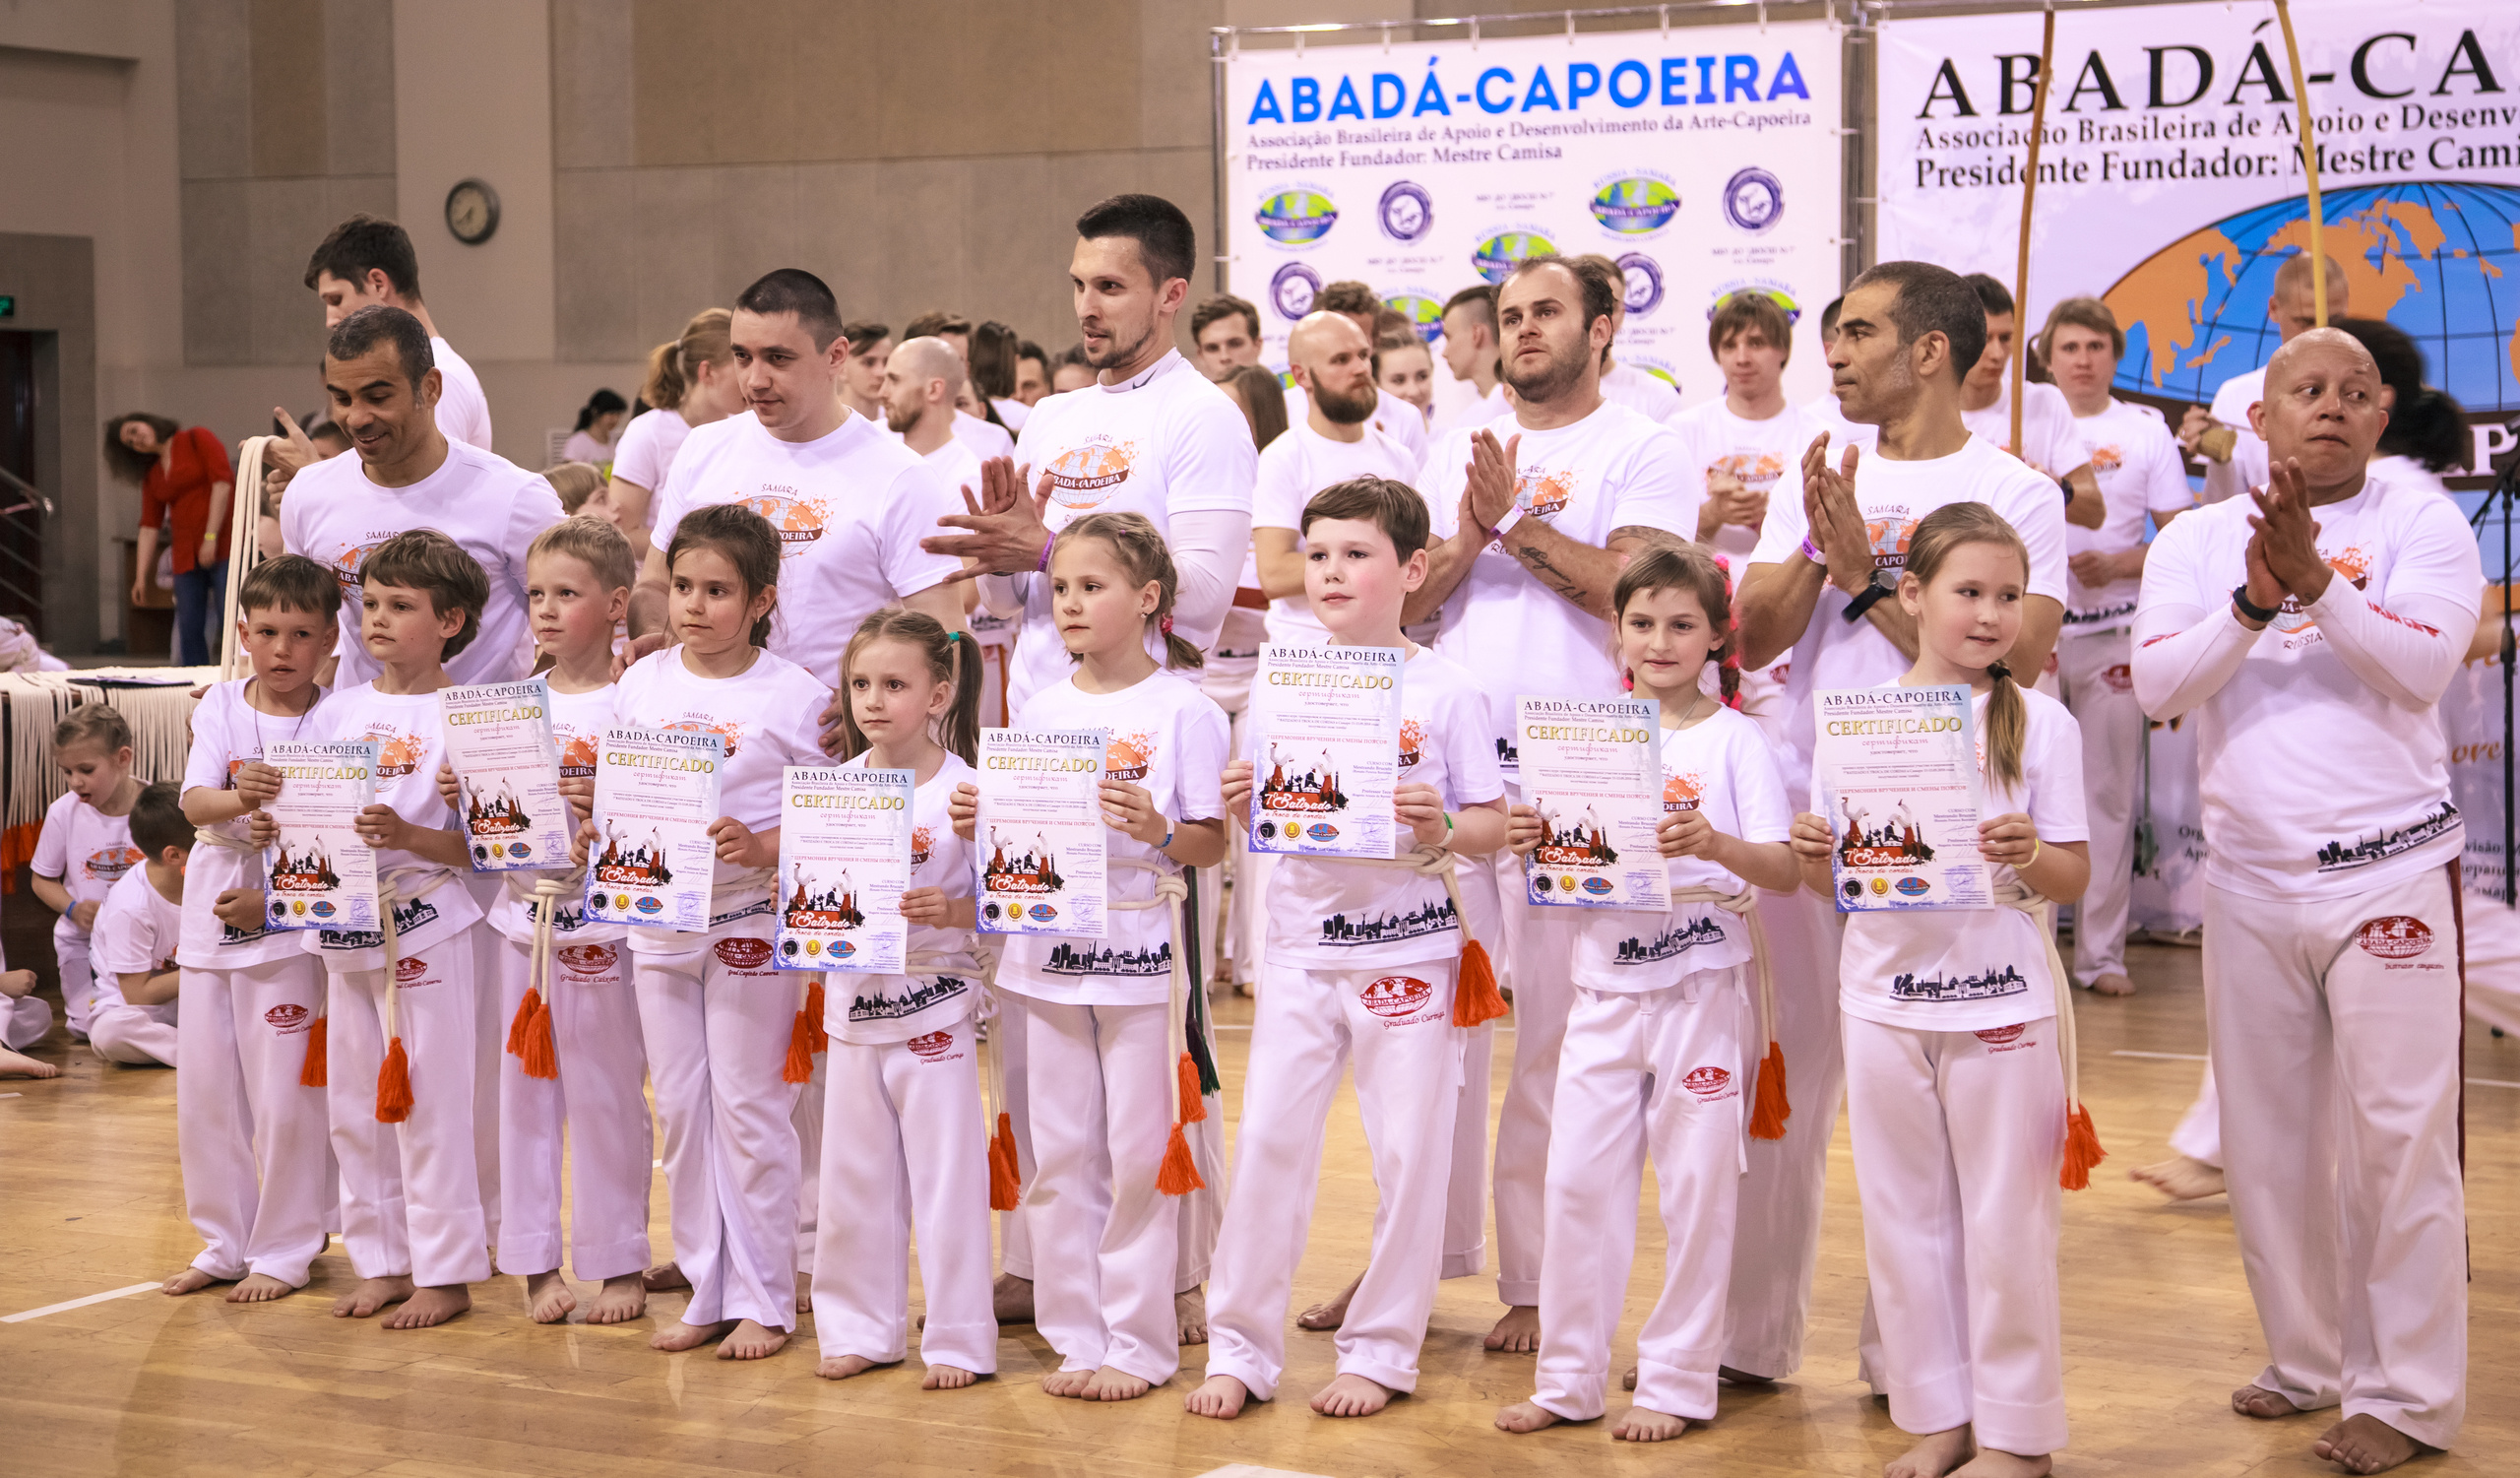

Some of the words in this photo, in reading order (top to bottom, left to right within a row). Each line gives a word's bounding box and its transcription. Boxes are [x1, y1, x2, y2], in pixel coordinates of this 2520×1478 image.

[1916, 18, 2520, 119] ABADÁ-CA
[1247, 49, 1811, 125] ABADÁ-CAPOEIRA
[1248, 132, 1332, 151] Associação
[1337, 128, 1412, 145] Brasileira
[1418, 126, 1437, 142] de
[1441, 124, 1491, 145] Apoio
[1496, 126, 1505, 138] e
[1510, 117, 1659, 138] Desenvolvimento
[1664, 115, 1684, 131] da
[1689, 109, 1812, 133] Arte-Capoeira
[2079, 113, 2216, 144] Brasileira
[2229, 110, 2261, 137] de
[2374, 112, 2390, 130] e
[1247, 151, 1335, 171] Presidente
[1340, 148, 1426, 167] Fundador:
[1432, 146, 1492, 163] Mestre
[1497, 143, 1563, 161] Camisa
[2102, 145, 2278, 183] Fundador:
[761, 483, 798, 496] SAMARA
[1867, 504, 1911, 515] SAMARA
[365, 530, 400, 541] SAMAR
[1268, 647, 1396, 662] ABADÁ-CAPOEIRA
[1267, 671, 1392, 690] CERTIFICADO
[444, 682, 540, 701] ABADÁ-CAPOEIRA
[1822, 690, 1962, 706] ABADÁ-CAPOEIRA
[449, 704, 542, 727] CERTIFICADO
[1523, 699, 1650, 714] ABADÁ-CAPOEIRA
[682, 711, 715, 723] SAMARA
[1525, 725, 1649, 743] CERTIFICADO
[1825, 716, 1963, 737] CERTIFICADO
[607, 729, 719, 747] ABADÁ-CAPOEIRA
[985, 731, 1100, 744] ABADÁ-CAPOEIRA
[271, 742, 369, 754] ABADÁ-CAPOEIRA
[605, 750, 715, 774] CERTIFICADO
[986, 755, 1098, 773] CERTIFICADO
[280, 765, 367, 780] ERTIFICADO
[792, 769, 908, 783] ABADÁ-CAPOEIRA
[791, 793, 905, 810] CERTIFICADO
[1272, 792, 1333, 810] Batizado
[475, 818, 521, 834] Batizado
[1544, 847, 1603, 865] Batizado
[1853, 848, 1918, 866] Batizado
[282, 874, 328, 890] Batizado
[605, 866, 660, 884] Batizado
[995, 874, 1049, 891] Batizado
[795, 911, 850, 929] Batizado
[1383, 1015, 1419, 1030] Graduado
